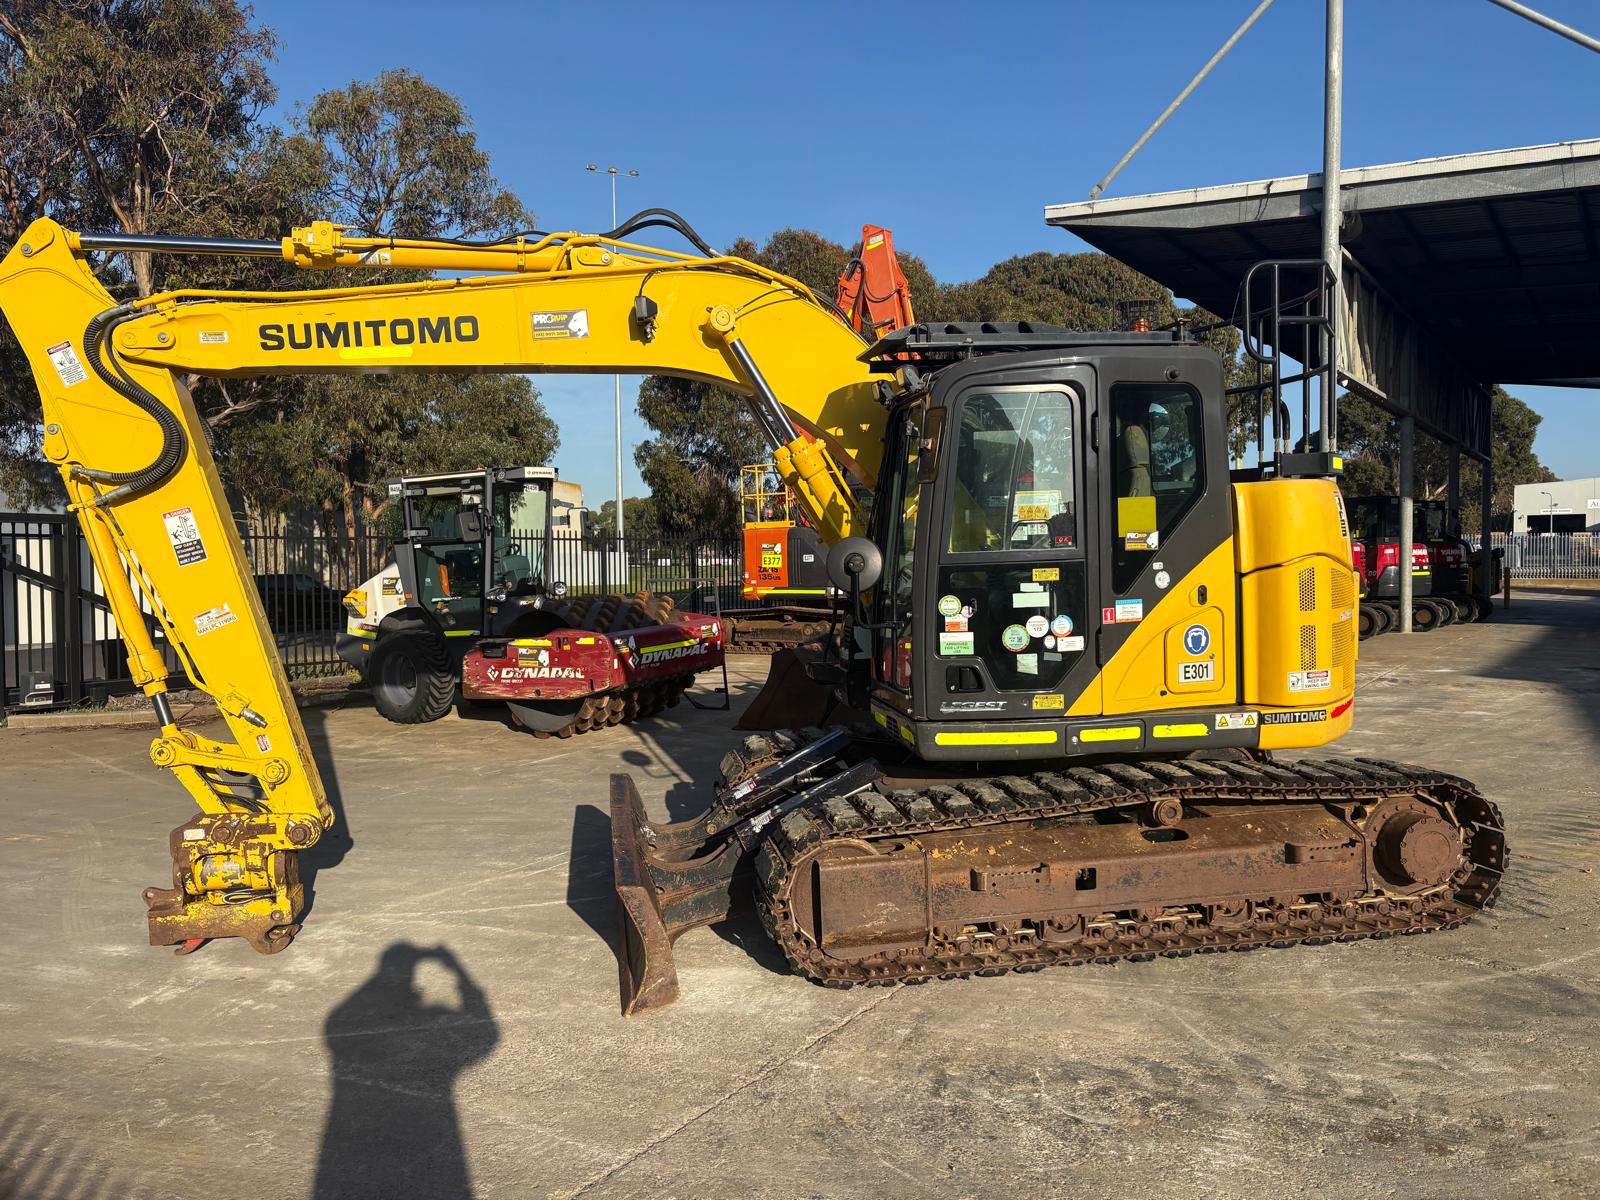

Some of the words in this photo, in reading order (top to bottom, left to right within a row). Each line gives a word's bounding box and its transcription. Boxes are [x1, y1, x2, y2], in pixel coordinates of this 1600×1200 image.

[259, 316, 479, 350] SUMITOMO
[763, 555, 781, 565] E377
[641, 643, 709, 664] DYNAPAC
[501, 667, 585, 679] DYNAPAC
[1183, 664, 1210, 680] E301
